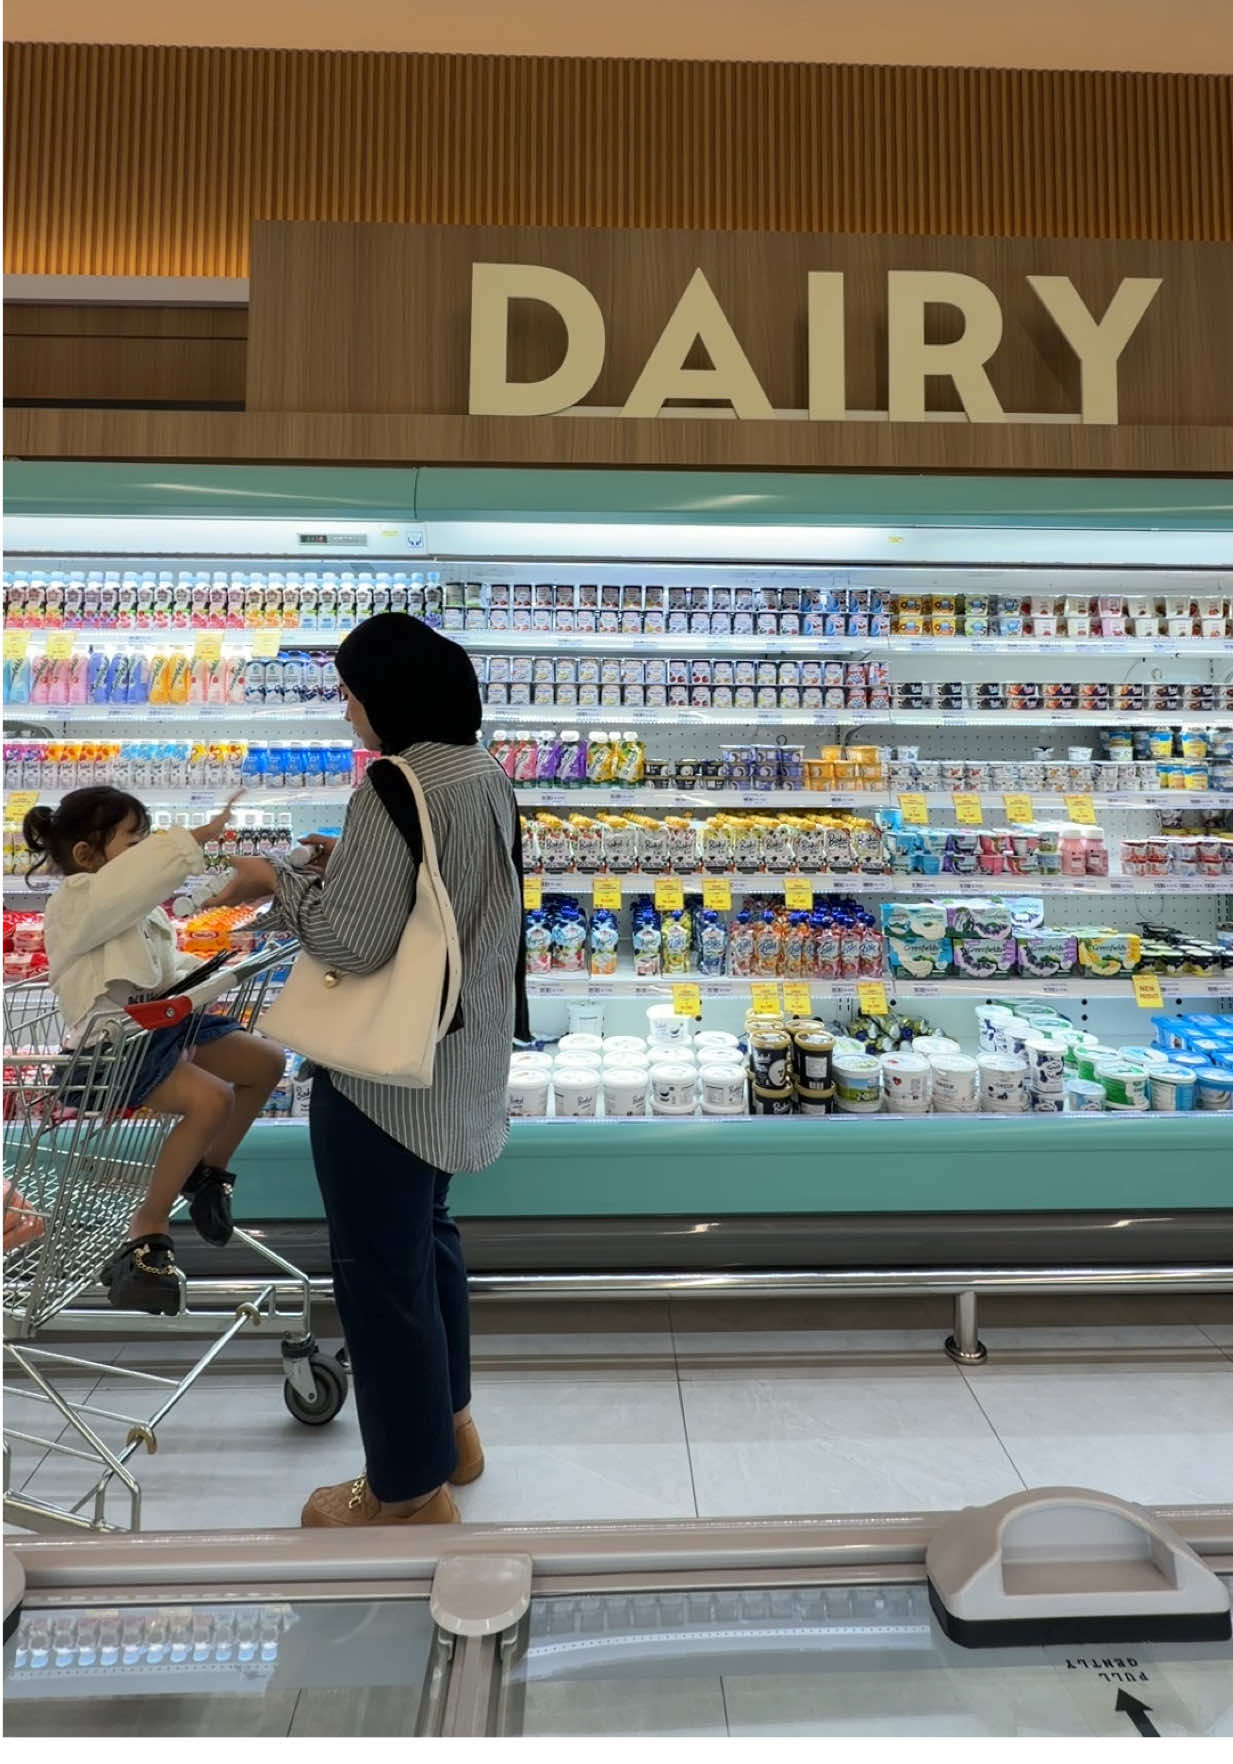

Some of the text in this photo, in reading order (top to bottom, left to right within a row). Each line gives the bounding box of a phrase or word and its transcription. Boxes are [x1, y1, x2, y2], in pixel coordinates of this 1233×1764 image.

[469, 262, 1164, 425] DAIRY
[1065, 1657, 1138, 1669] GENTLY
[1098, 1671, 1149, 1682] PULL
